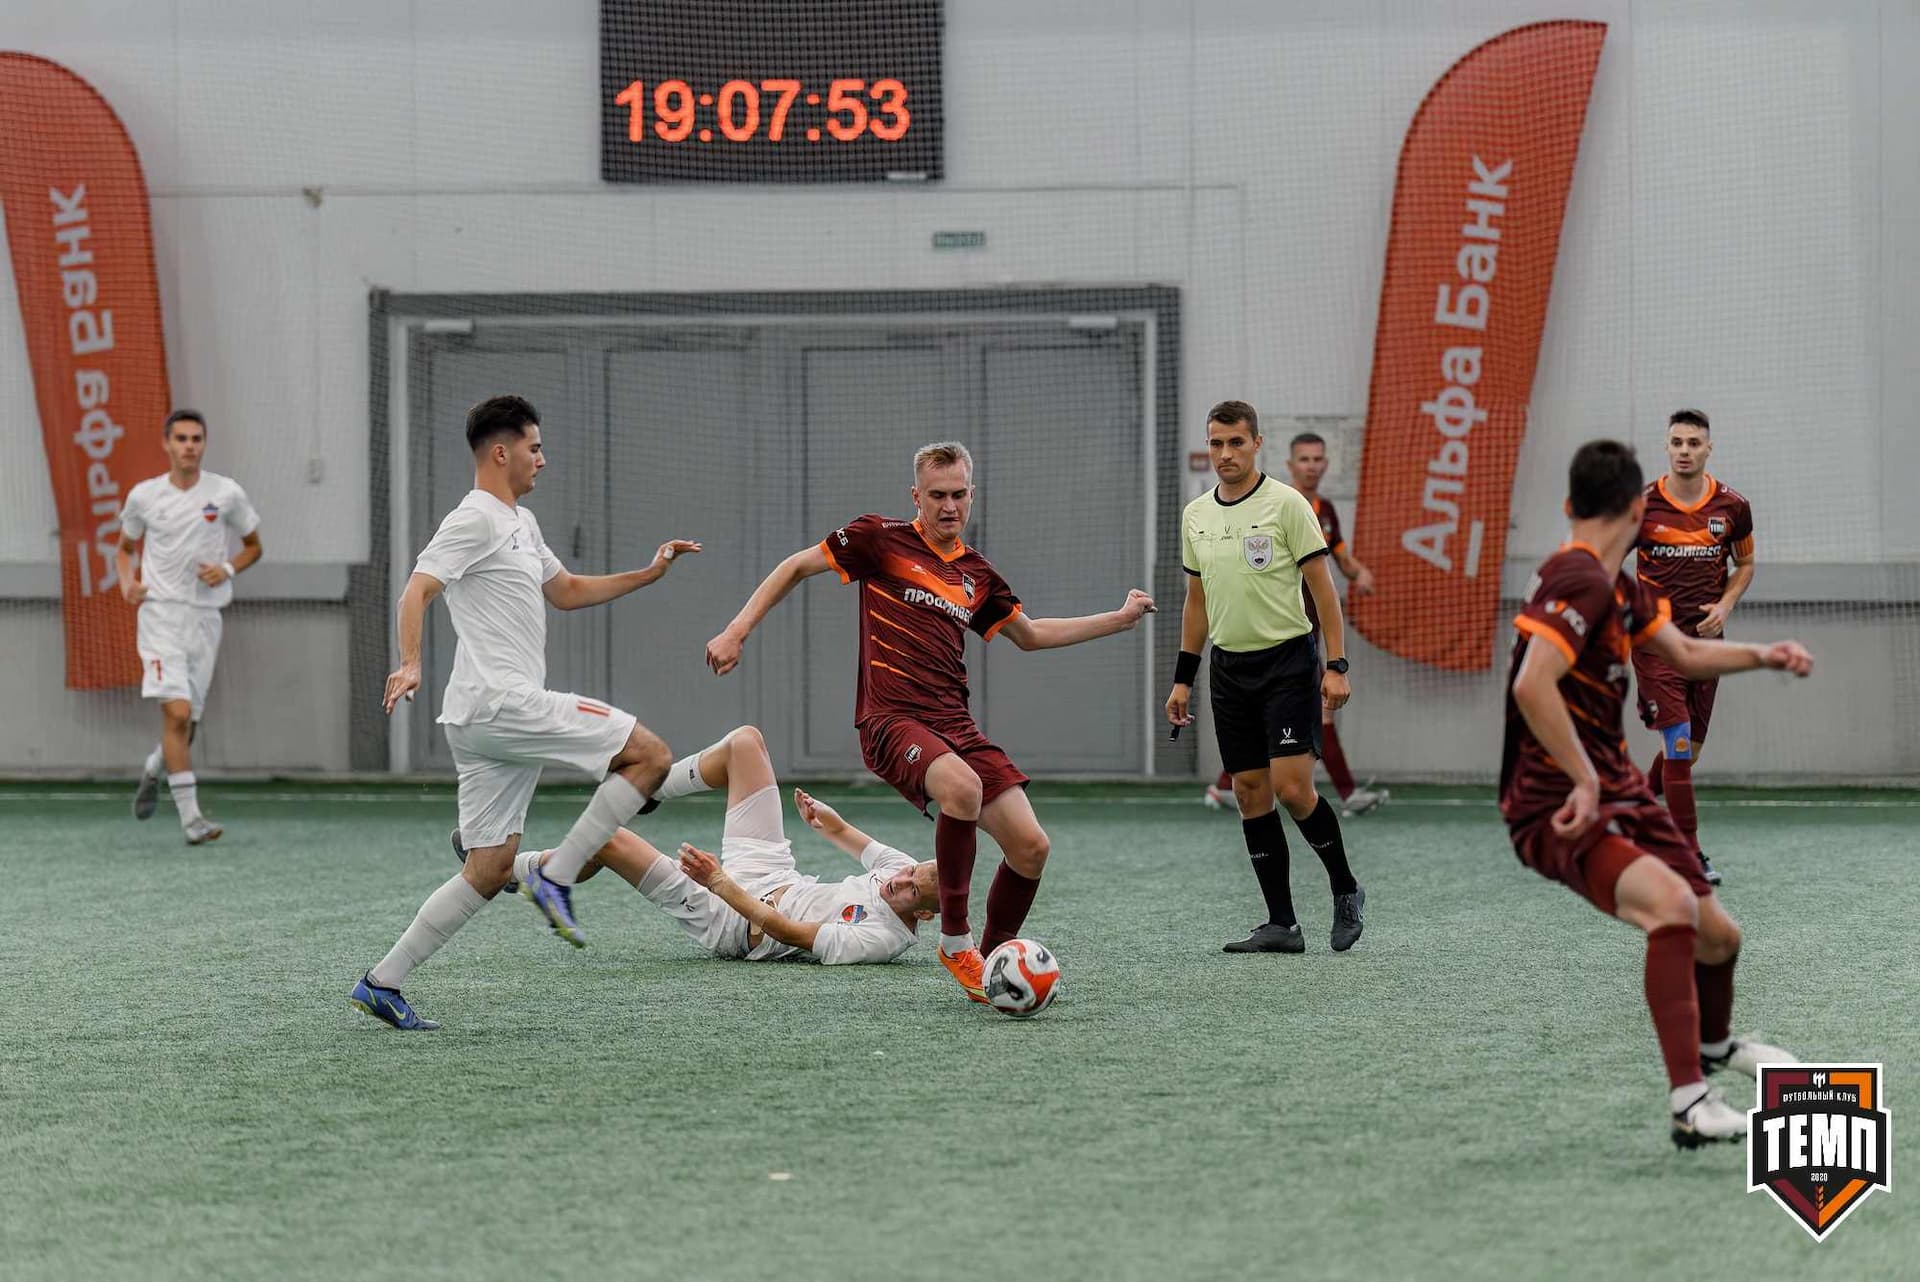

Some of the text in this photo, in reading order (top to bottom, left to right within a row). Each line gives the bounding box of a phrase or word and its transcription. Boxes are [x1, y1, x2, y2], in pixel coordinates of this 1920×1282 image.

[615, 78, 911, 142] 19:07:53
[1401, 152, 1514, 573] Альфа Банк
